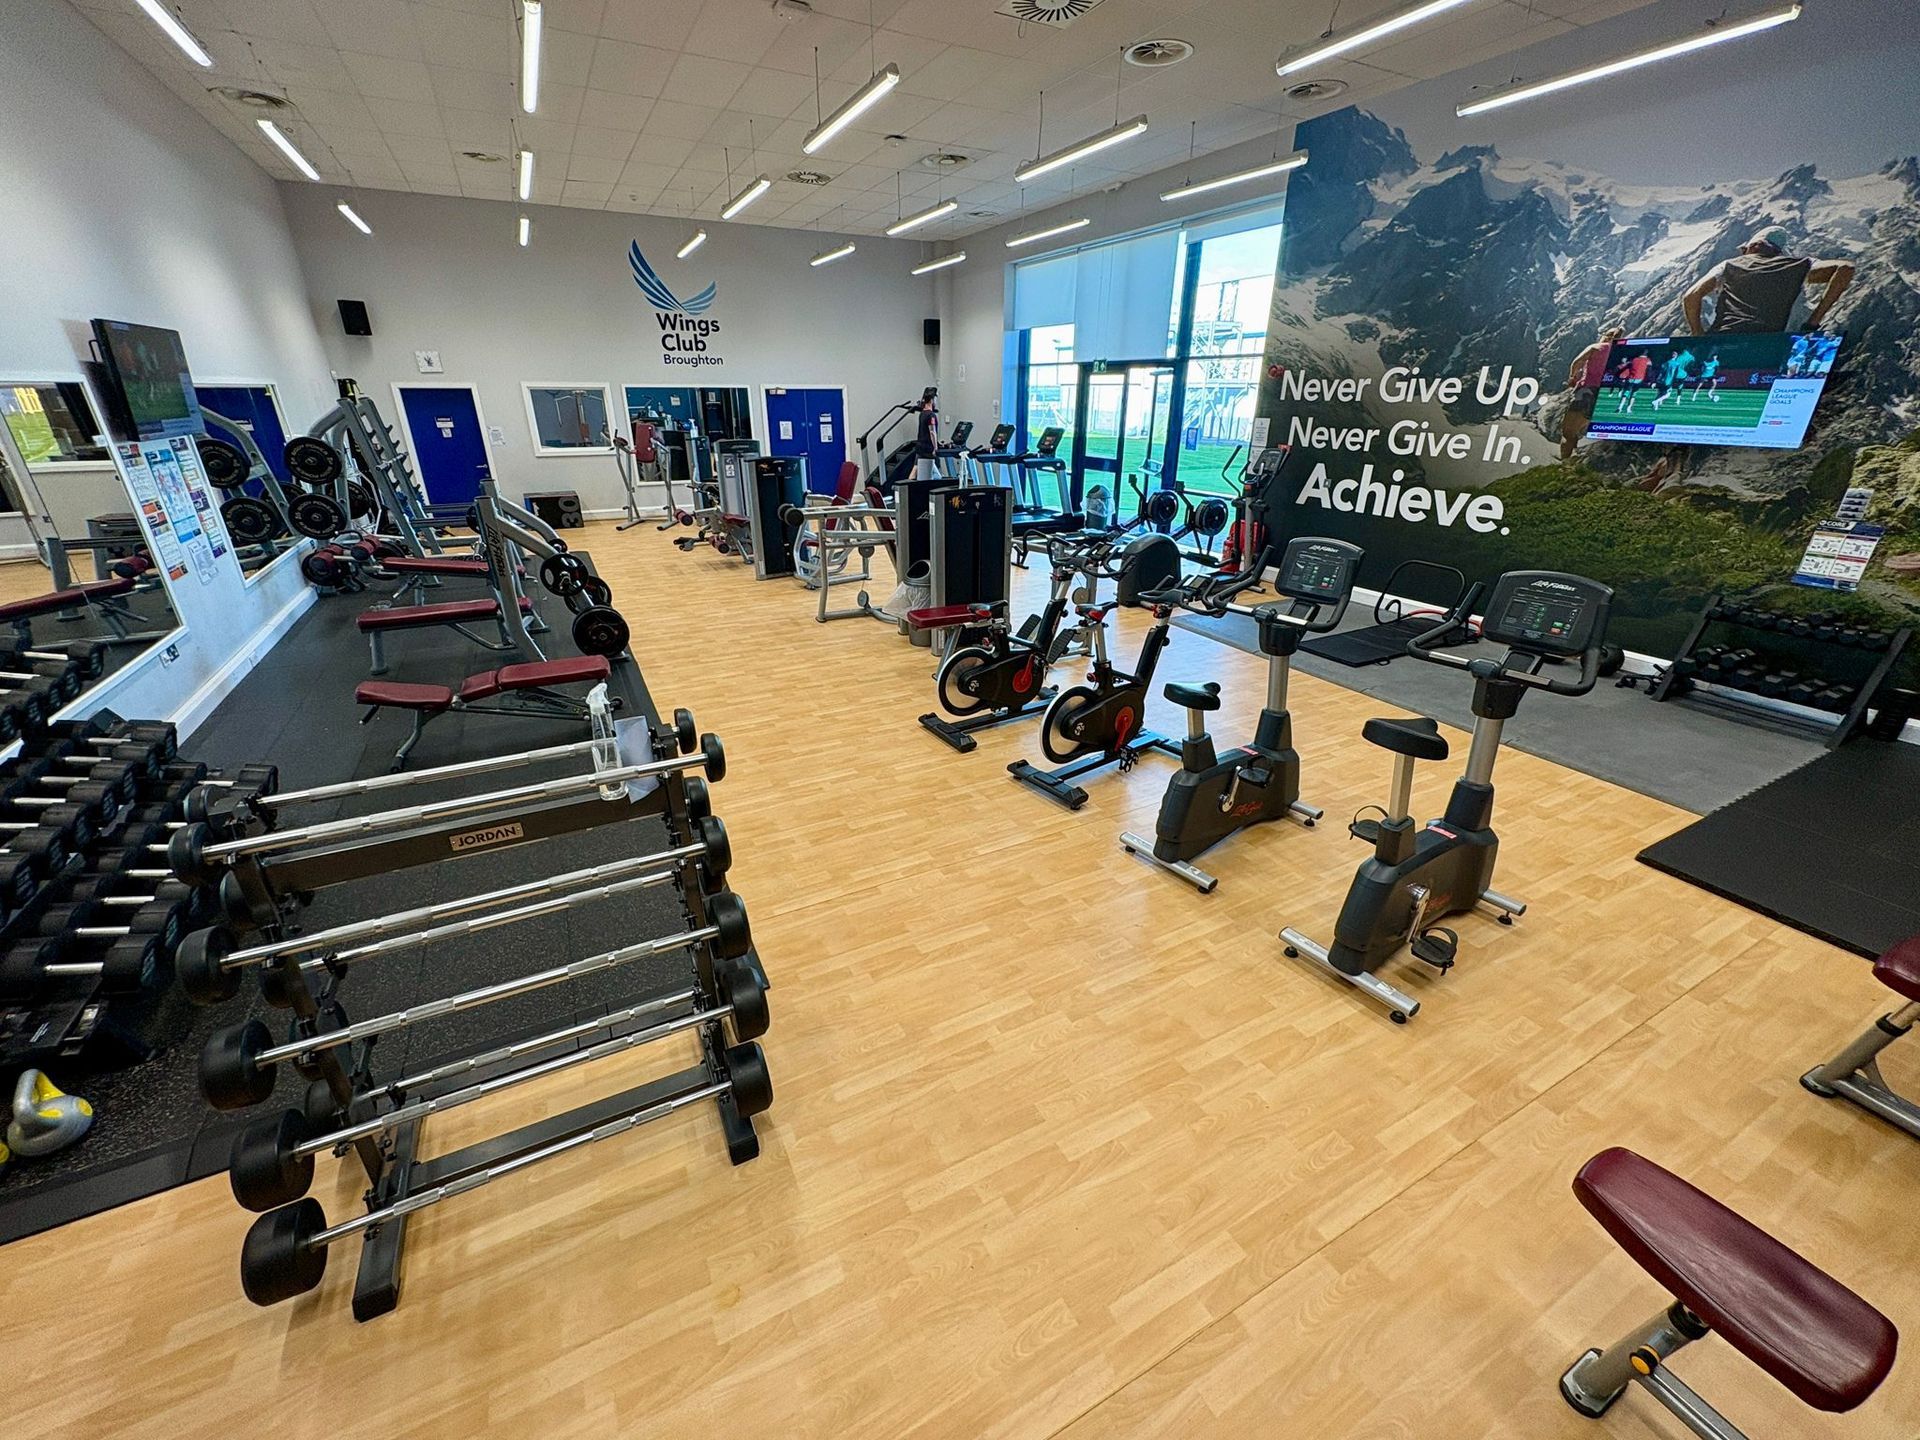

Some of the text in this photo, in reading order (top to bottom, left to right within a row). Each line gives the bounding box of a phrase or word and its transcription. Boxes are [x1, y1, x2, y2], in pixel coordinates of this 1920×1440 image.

[656, 313, 720, 337] Wings
[661, 333, 706, 351] Club
[663, 354, 723, 367] Broughton
[1280, 365, 1548, 417] Never Give Up.
[1287, 416, 1380, 452] Never
[1387, 419, 1472, 460] Give
[1482, 424, 1531, 465] In.
[1295, 462, 1510, 536] Achieve.
[458, 826, 517, 847] JORDAN
